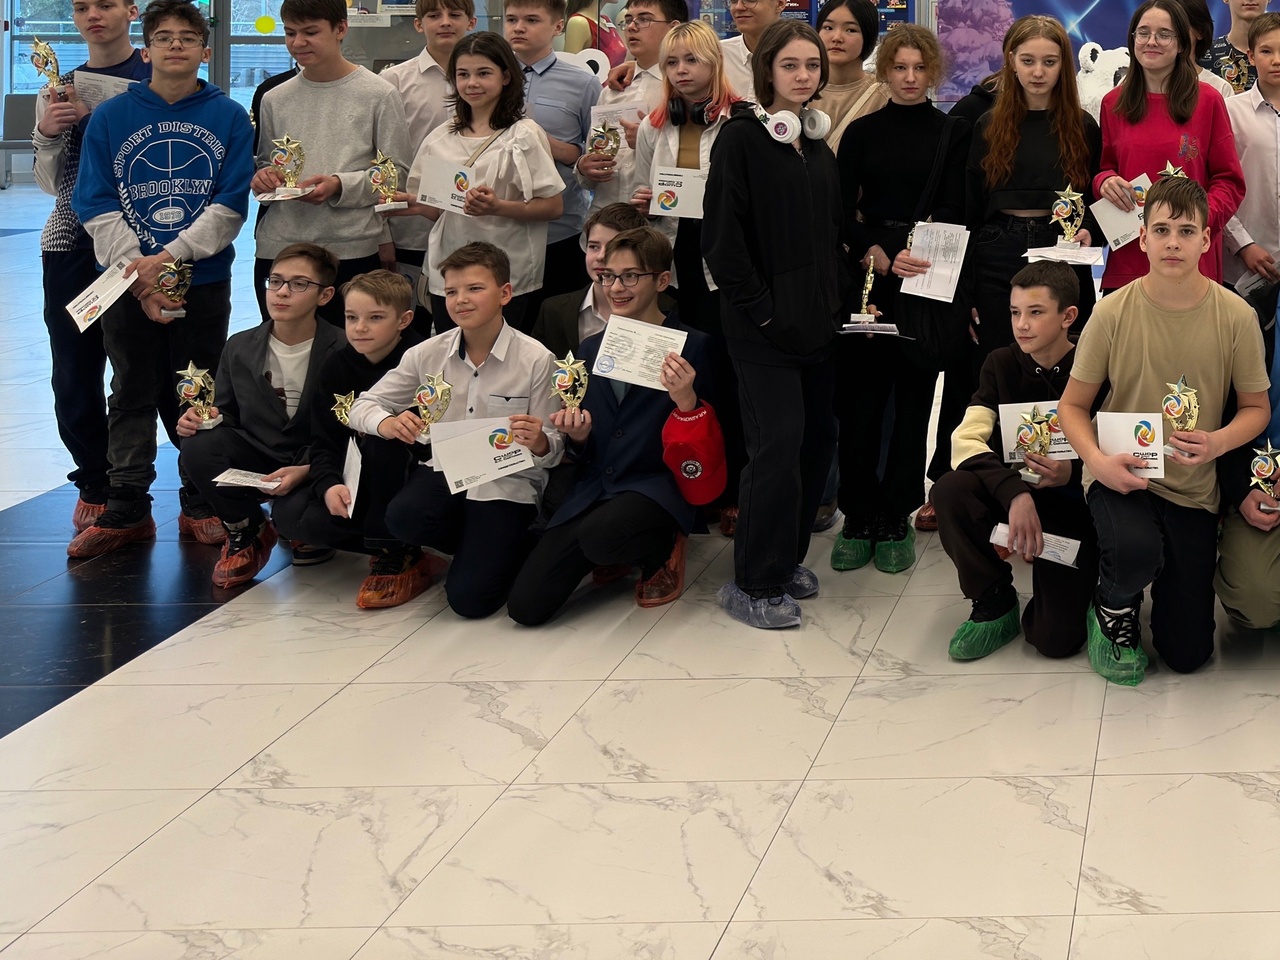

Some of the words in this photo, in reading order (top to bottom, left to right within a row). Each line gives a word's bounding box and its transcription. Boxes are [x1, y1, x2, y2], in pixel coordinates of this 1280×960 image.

[113, 124, 153, 178] SPORT
[158, 121, 226, 171] DISTRIC
[128, 178, 212, 201] BROOKLYN
